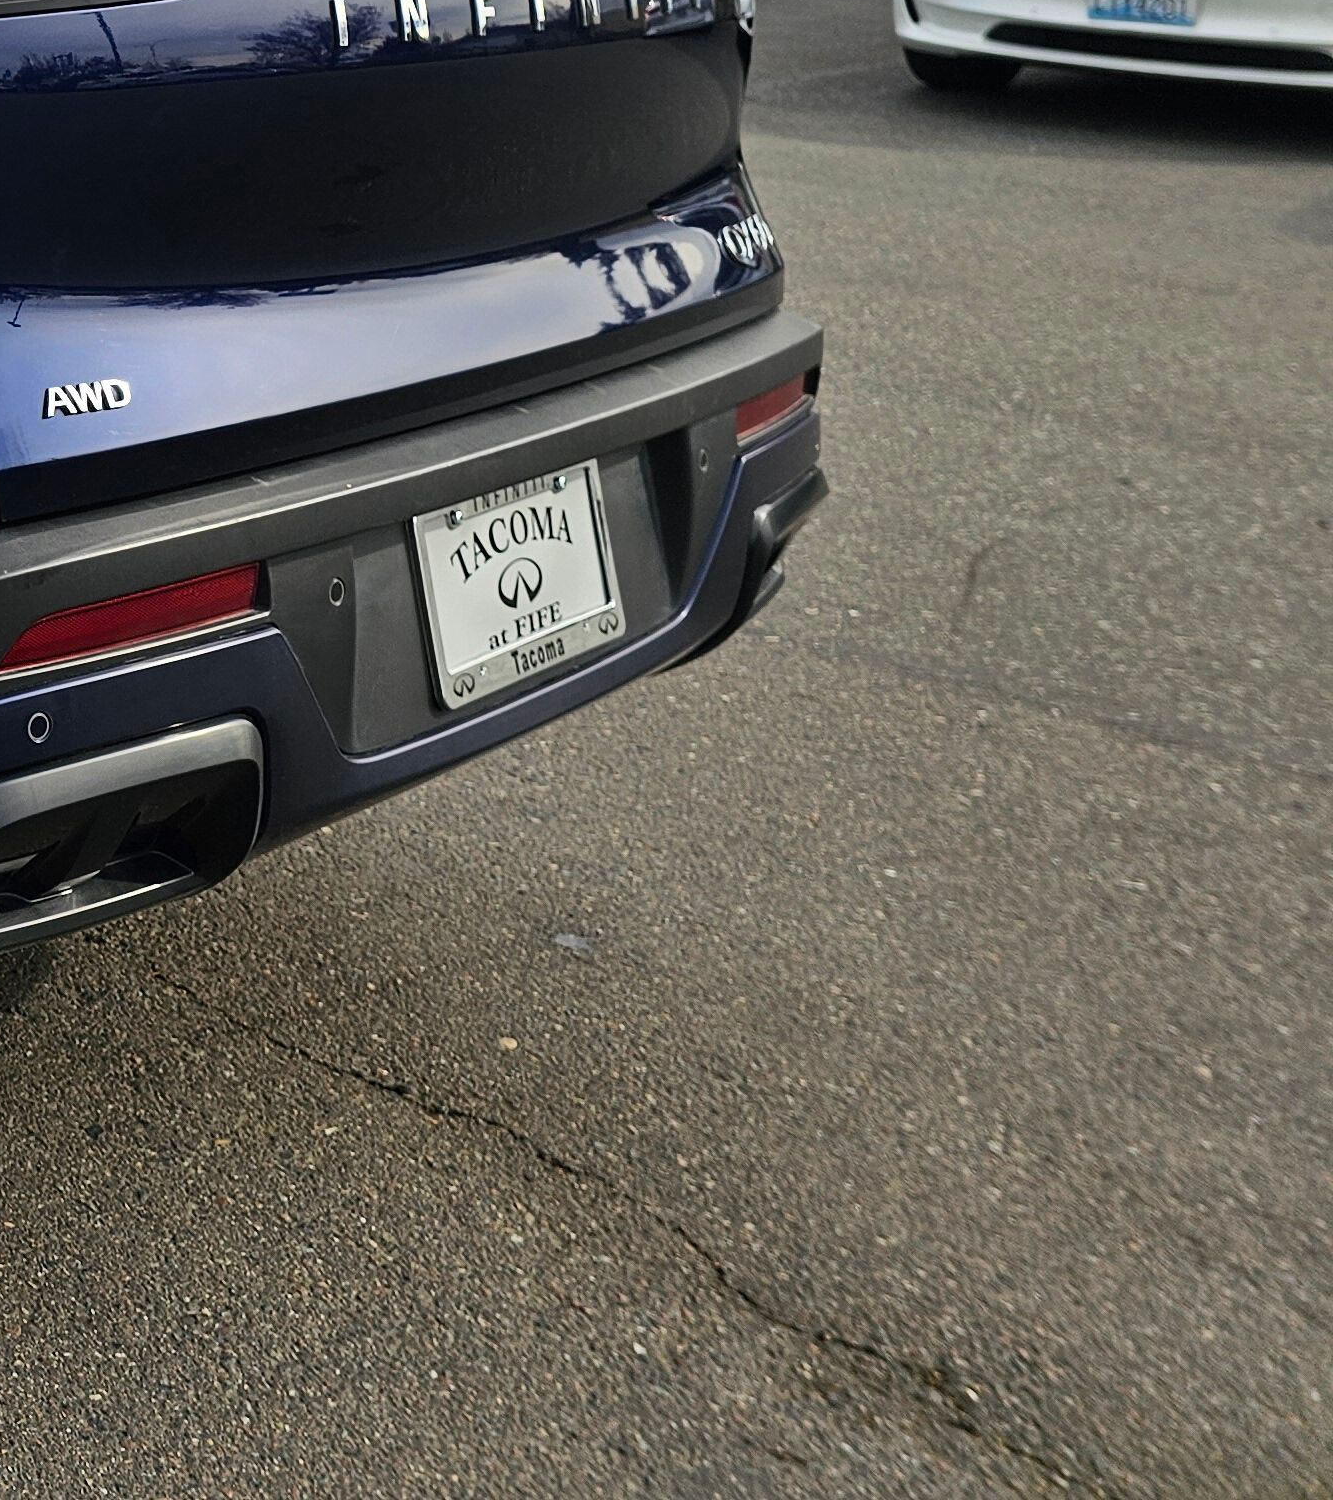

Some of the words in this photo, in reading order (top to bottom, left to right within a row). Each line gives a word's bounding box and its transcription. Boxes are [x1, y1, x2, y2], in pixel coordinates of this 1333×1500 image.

[42, 379, 132, 419] AWD
[450, 506, 573, 583] TACOMA
[489, 629, 508, 650] at
[514, 601, 562, 639] FIFE
[511, 637, 565, 675] Tacoma
